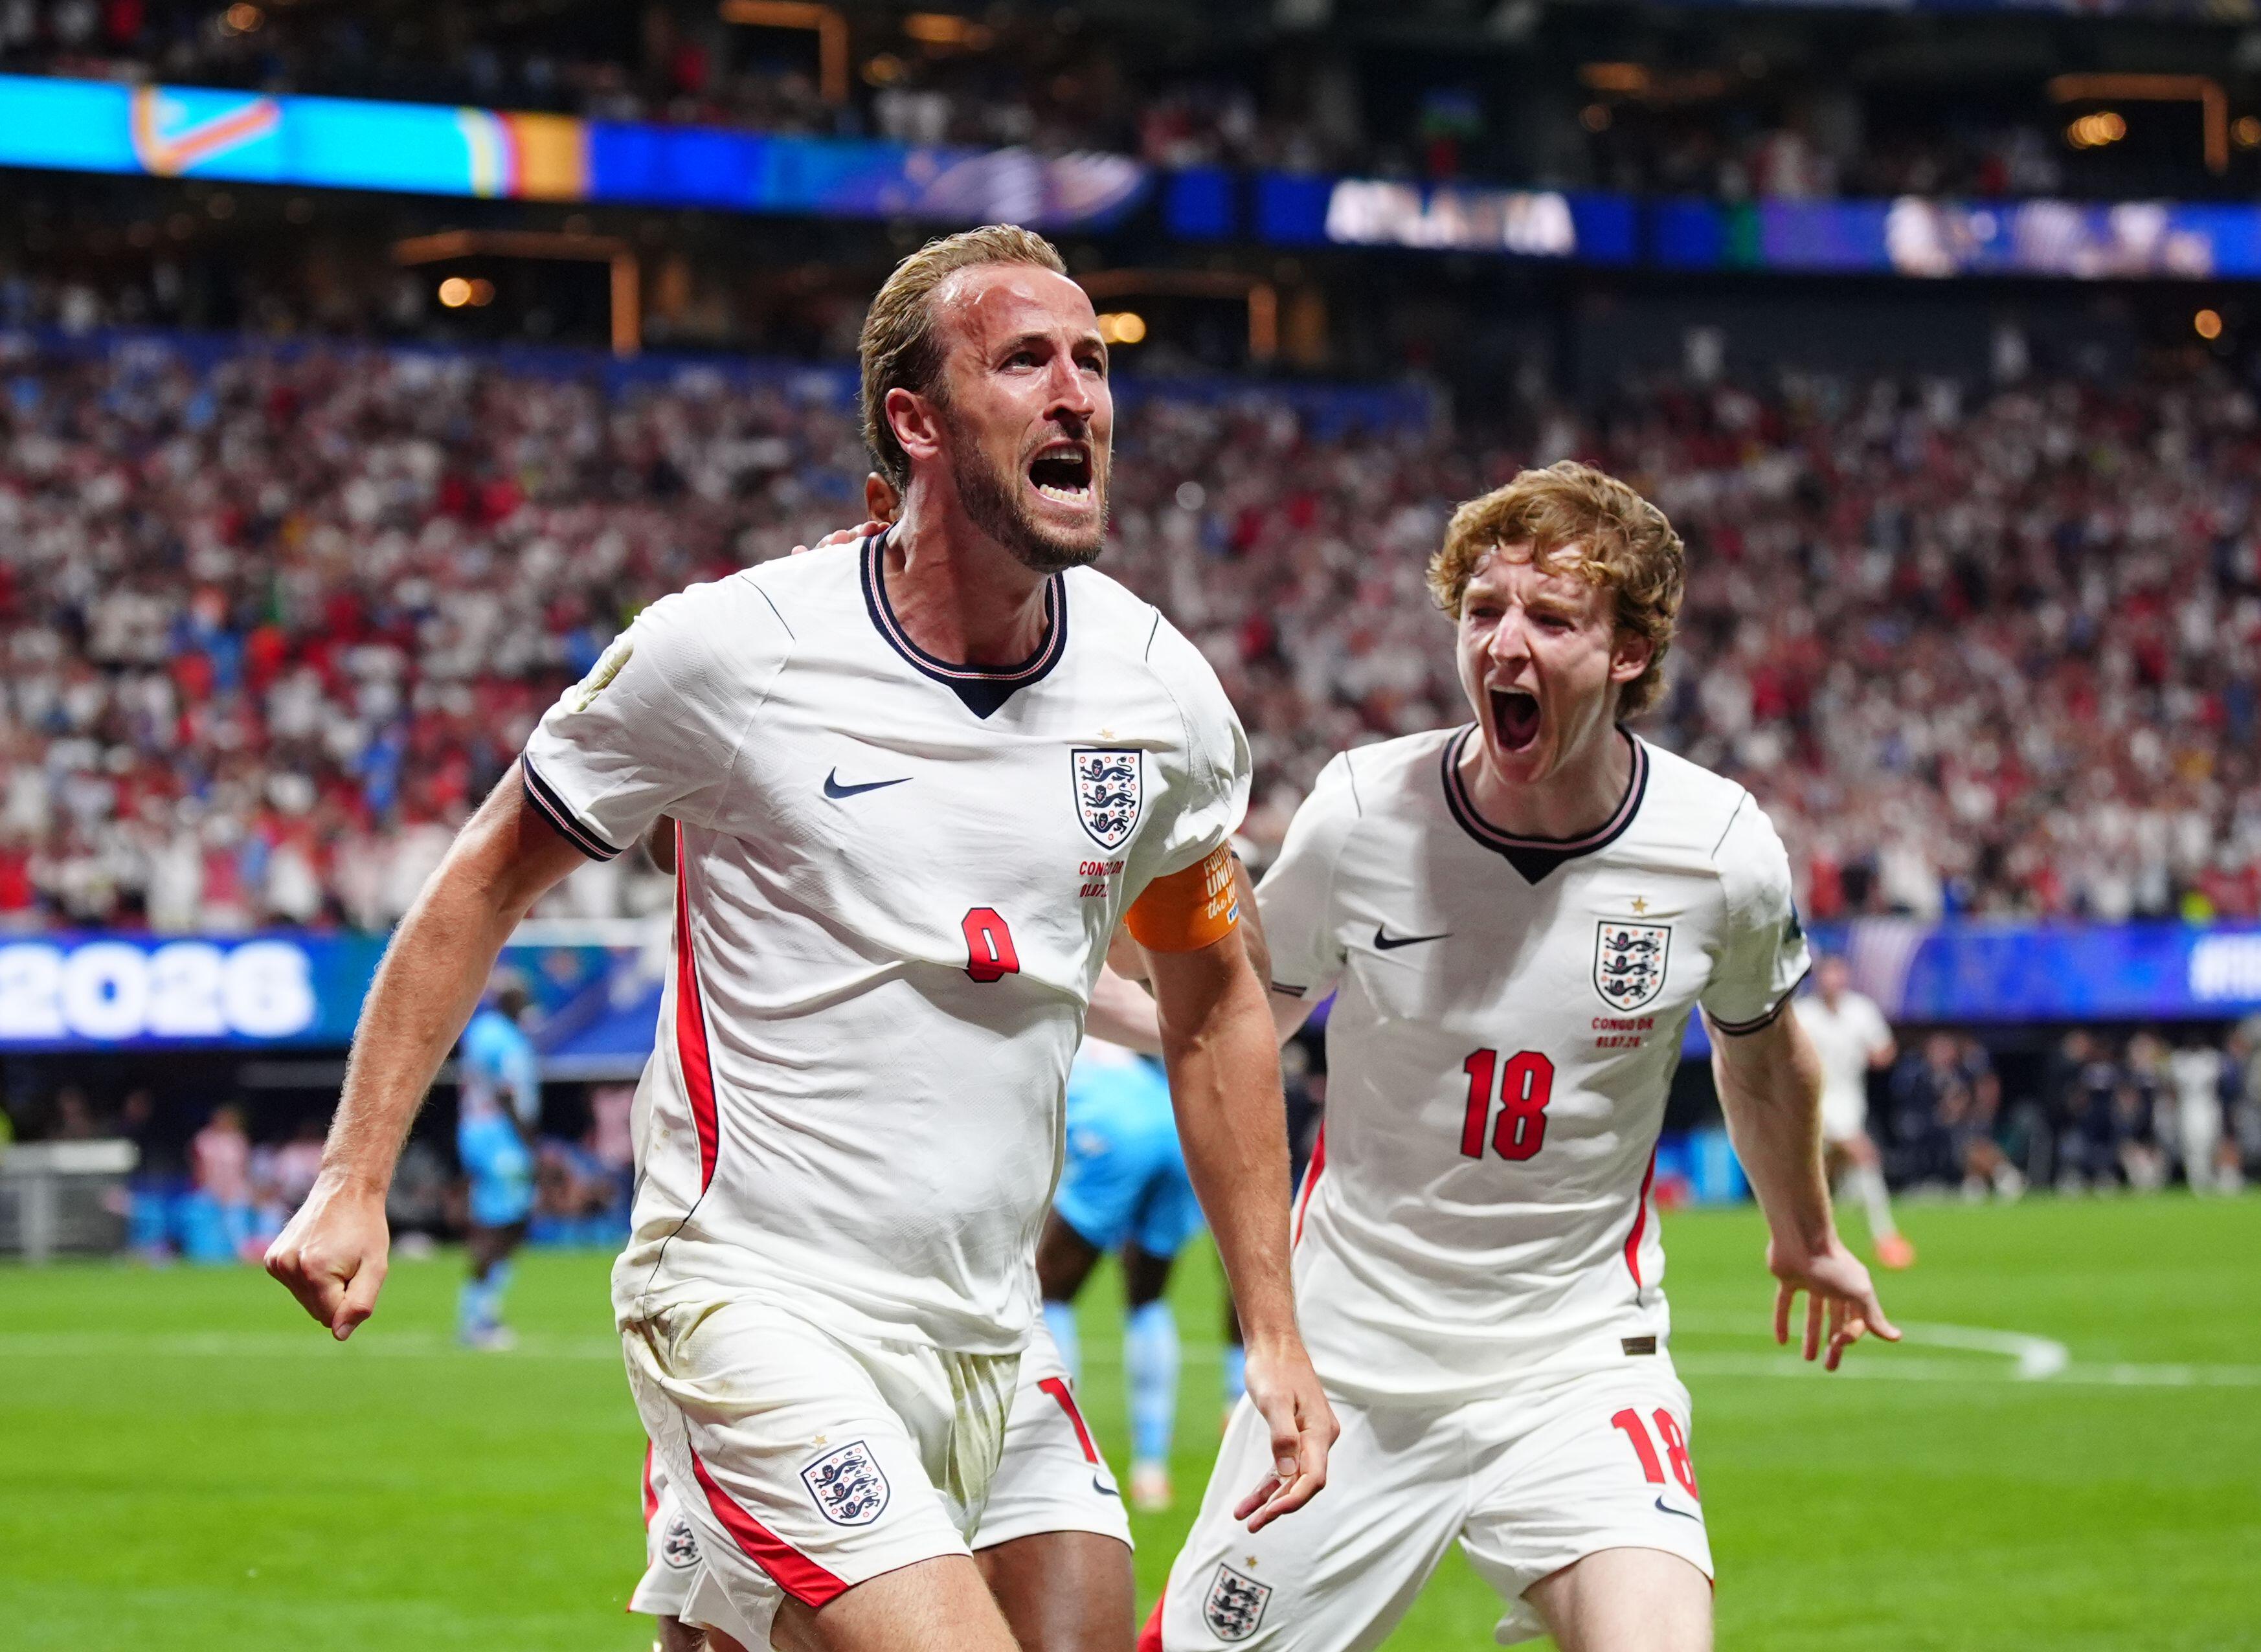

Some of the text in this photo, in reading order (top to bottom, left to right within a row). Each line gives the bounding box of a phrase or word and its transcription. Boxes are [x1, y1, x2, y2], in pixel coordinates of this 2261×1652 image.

[0, 941, 313, 1039] 2026
[1592, 1017, 1655, 1031] CONGO DR
[1460, 1047, 1555, 1161] 18
[1610, 1407, 1700, 1502] 18
